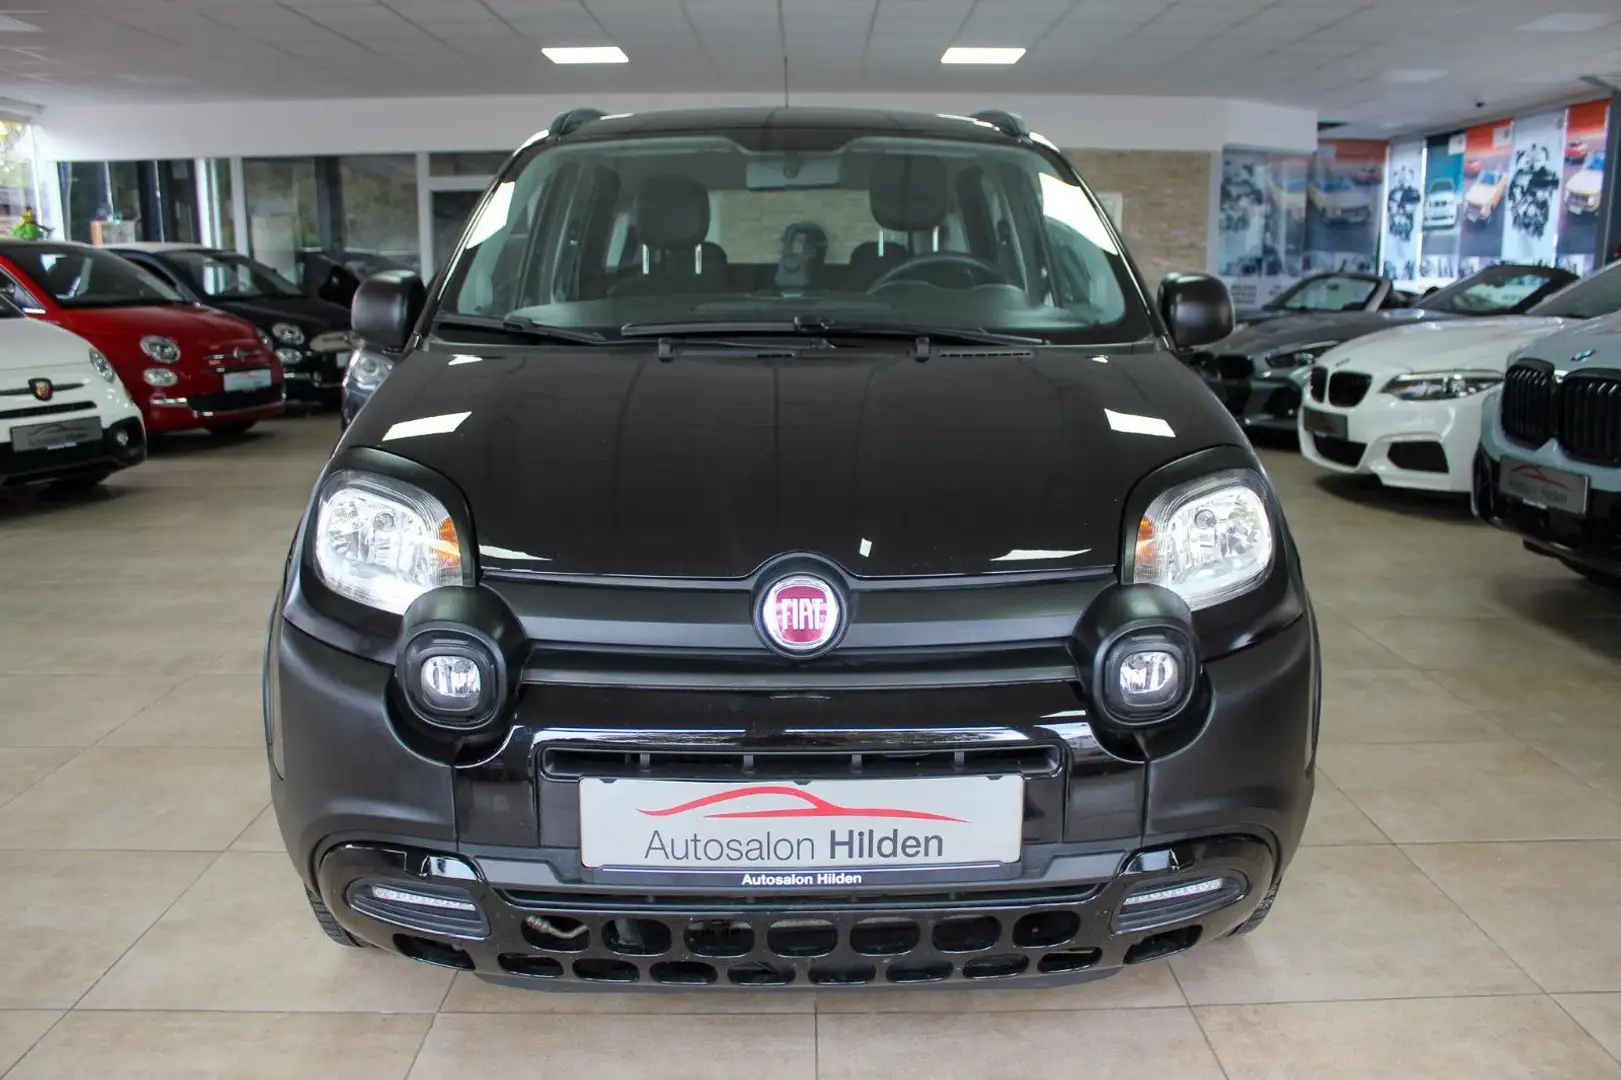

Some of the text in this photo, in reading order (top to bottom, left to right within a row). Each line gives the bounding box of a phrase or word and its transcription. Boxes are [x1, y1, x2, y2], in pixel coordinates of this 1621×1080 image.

[781, 598, 824, 630] FIAT
[644, 828, 943, 861] Autosalon Hilden
[741, 873, 863, 886] Autosalon Hilden
